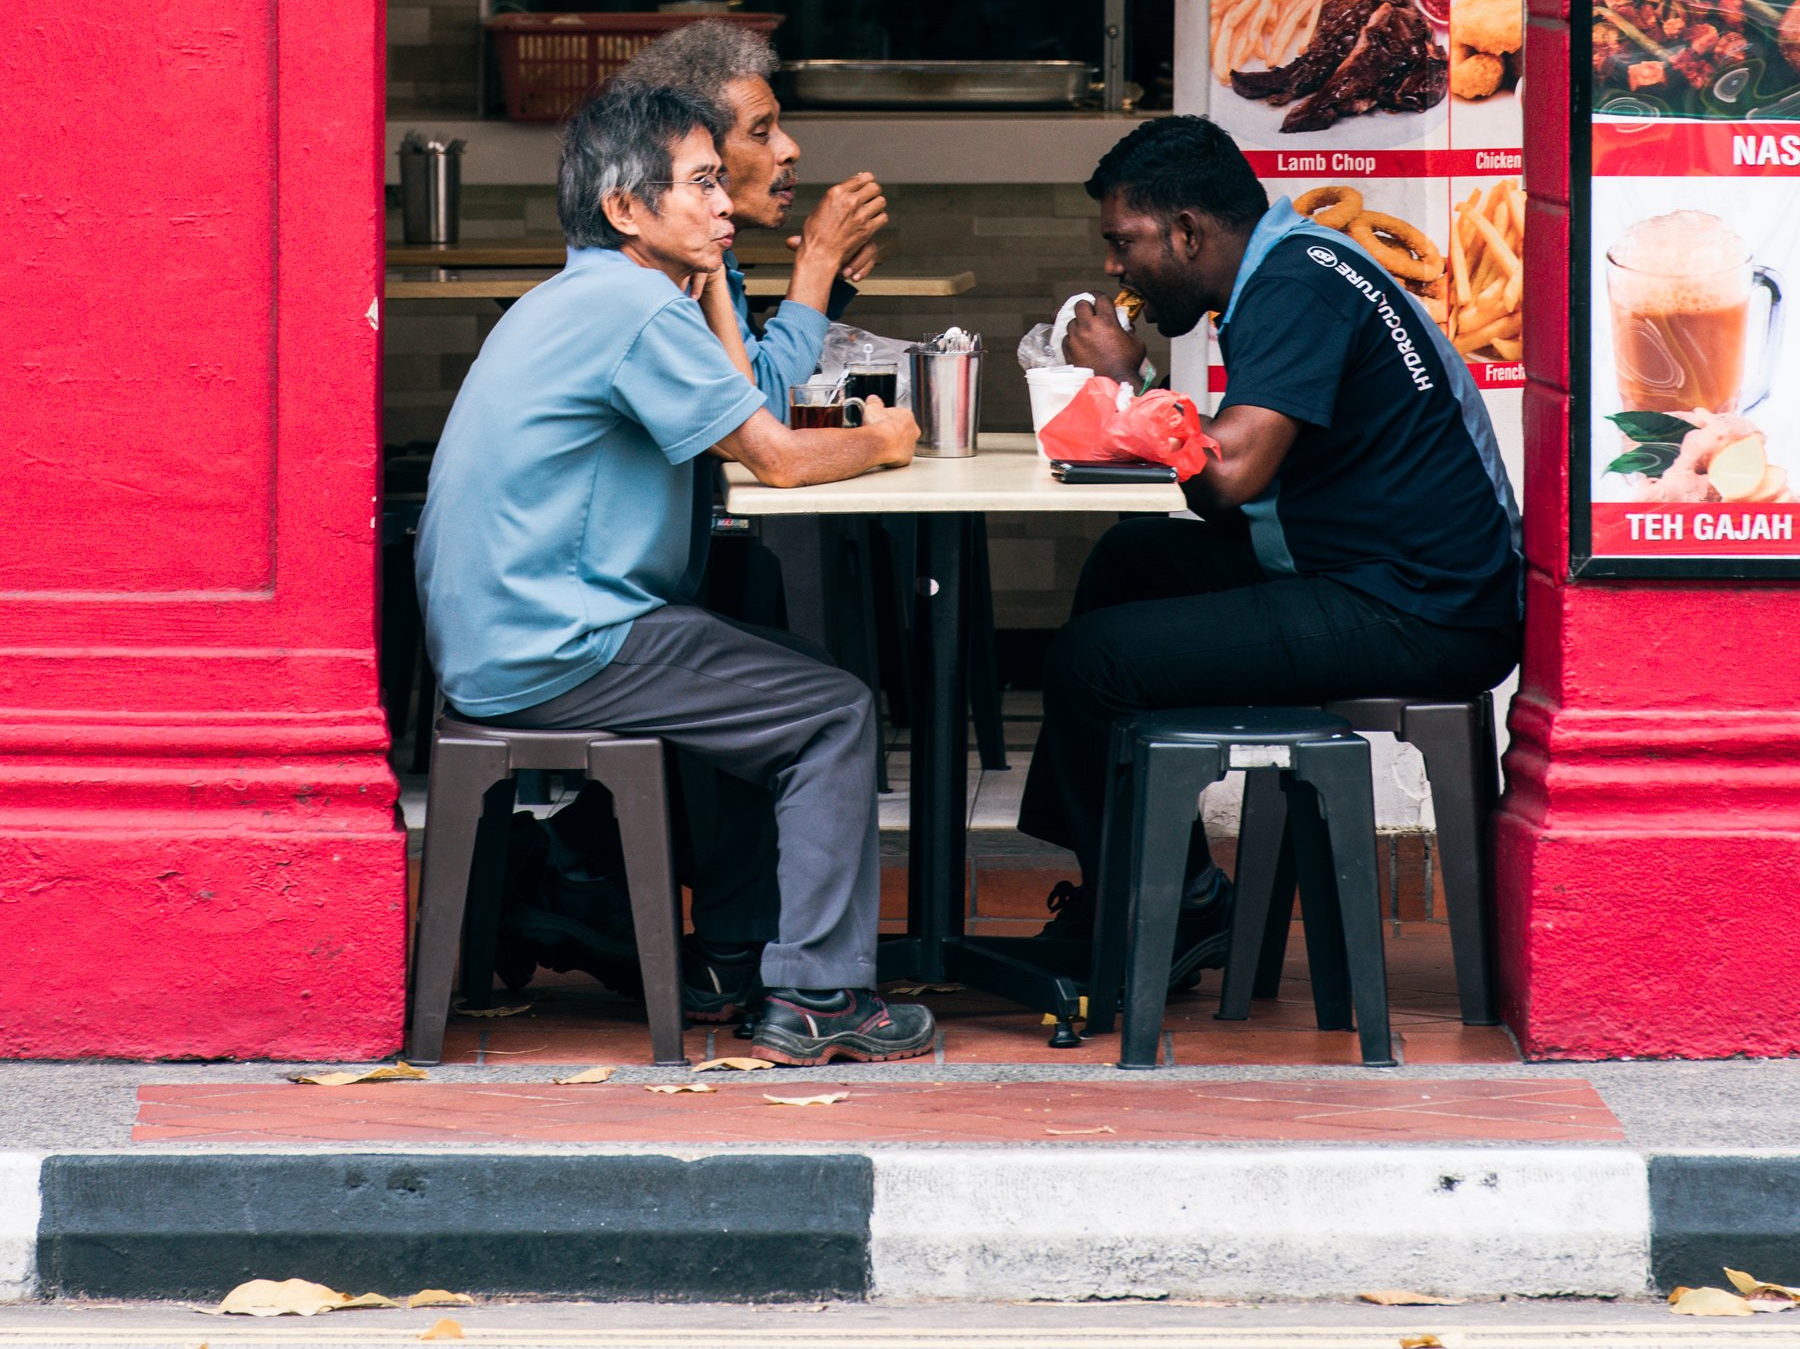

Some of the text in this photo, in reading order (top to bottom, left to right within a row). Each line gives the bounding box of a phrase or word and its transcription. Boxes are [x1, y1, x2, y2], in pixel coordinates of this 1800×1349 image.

[1476, 152, 1521, 169] Chicken
[1733, 135, 1800, 166] NAS
[1277, 154, 1376, 174] Lamb Chop
[1334, 261, 1434, 391] HYDROCULTURE
[1485, 363, 1526, 381] French
[1625, 513, 1792, 541] TEH GAJAH
